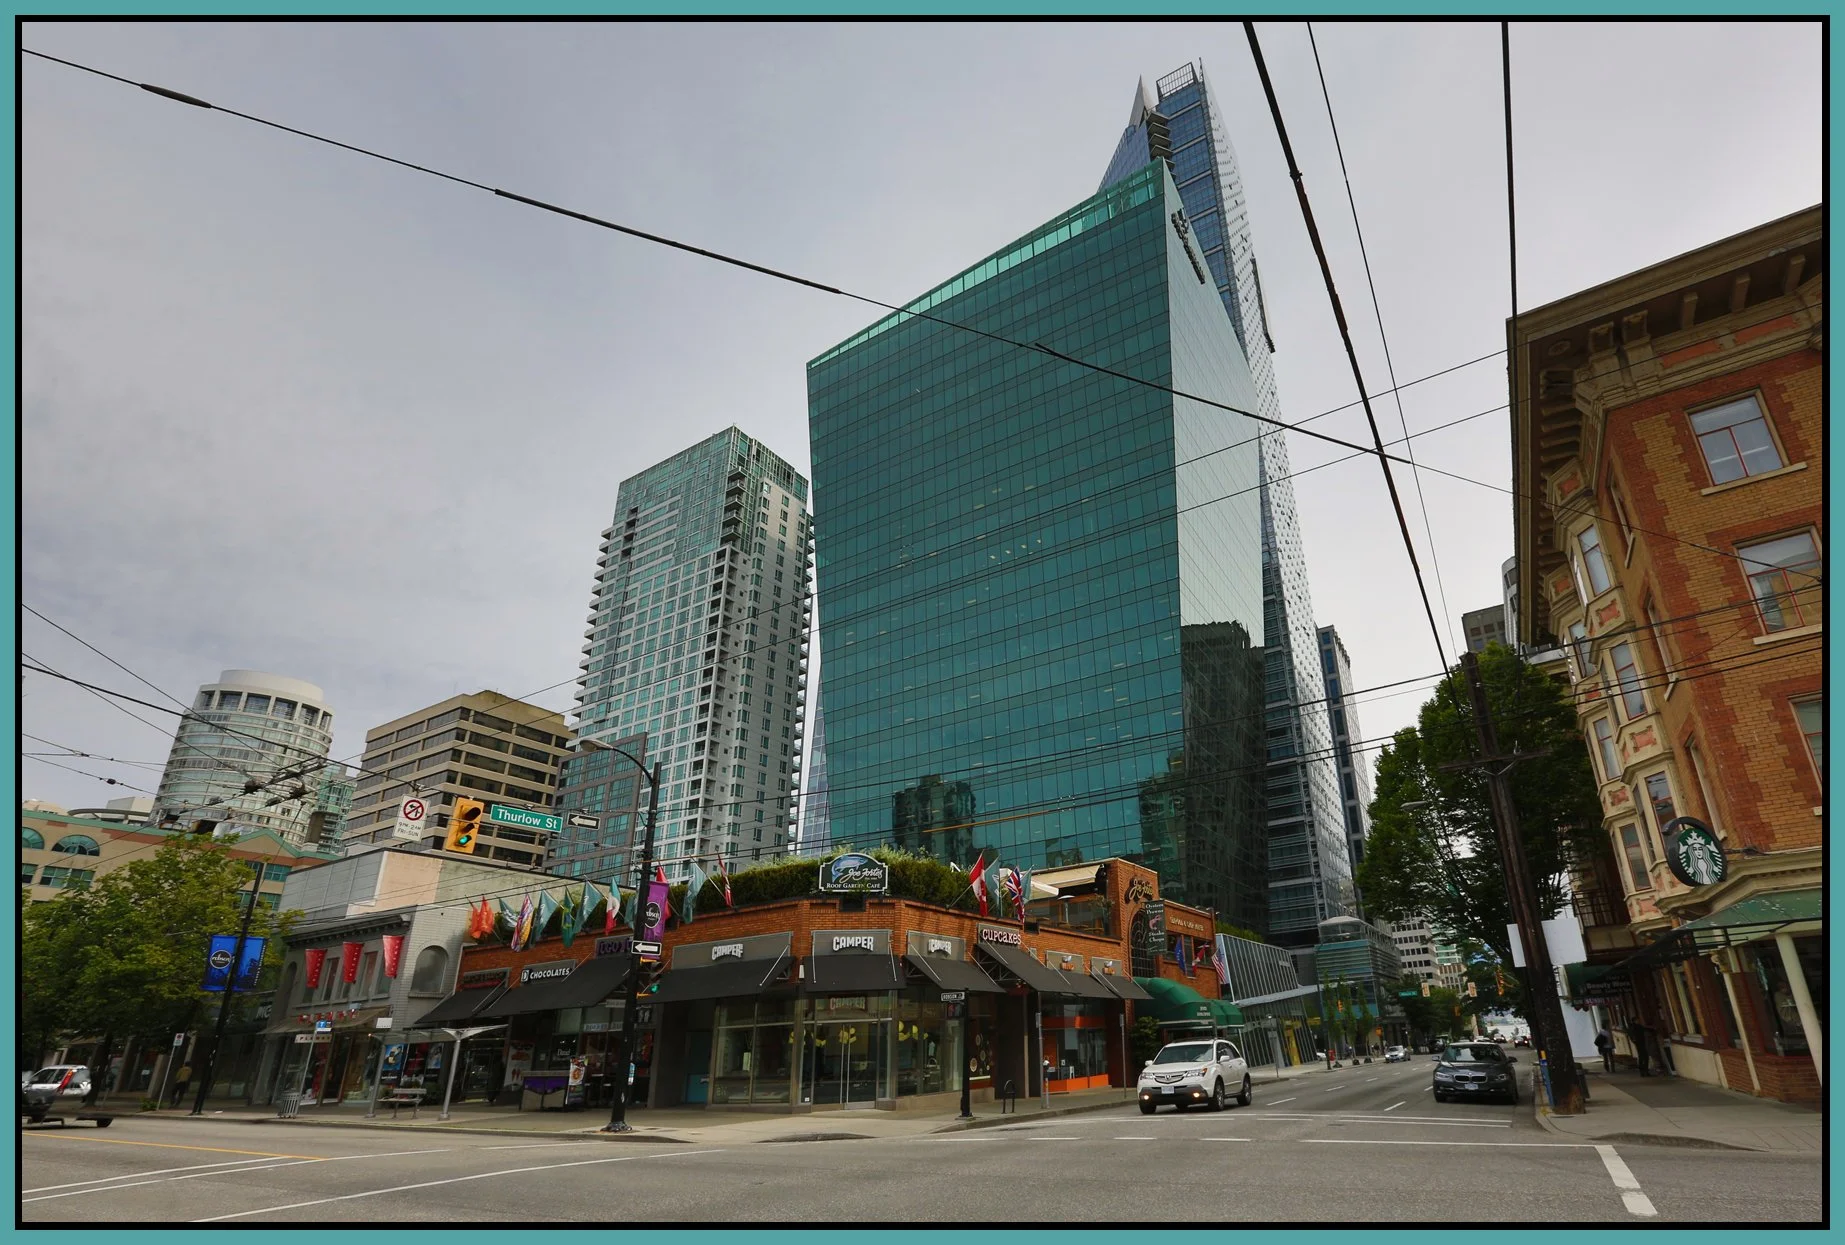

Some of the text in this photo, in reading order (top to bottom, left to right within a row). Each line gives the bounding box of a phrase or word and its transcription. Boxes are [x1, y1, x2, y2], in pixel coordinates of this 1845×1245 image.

[497, 808, 558, 829] Thurlow St
[711, 943, 744, 961] CAMPER
[832, 936, 874, 952] CAMPER
[529, 967, 570, 980] CHOCOLATES
